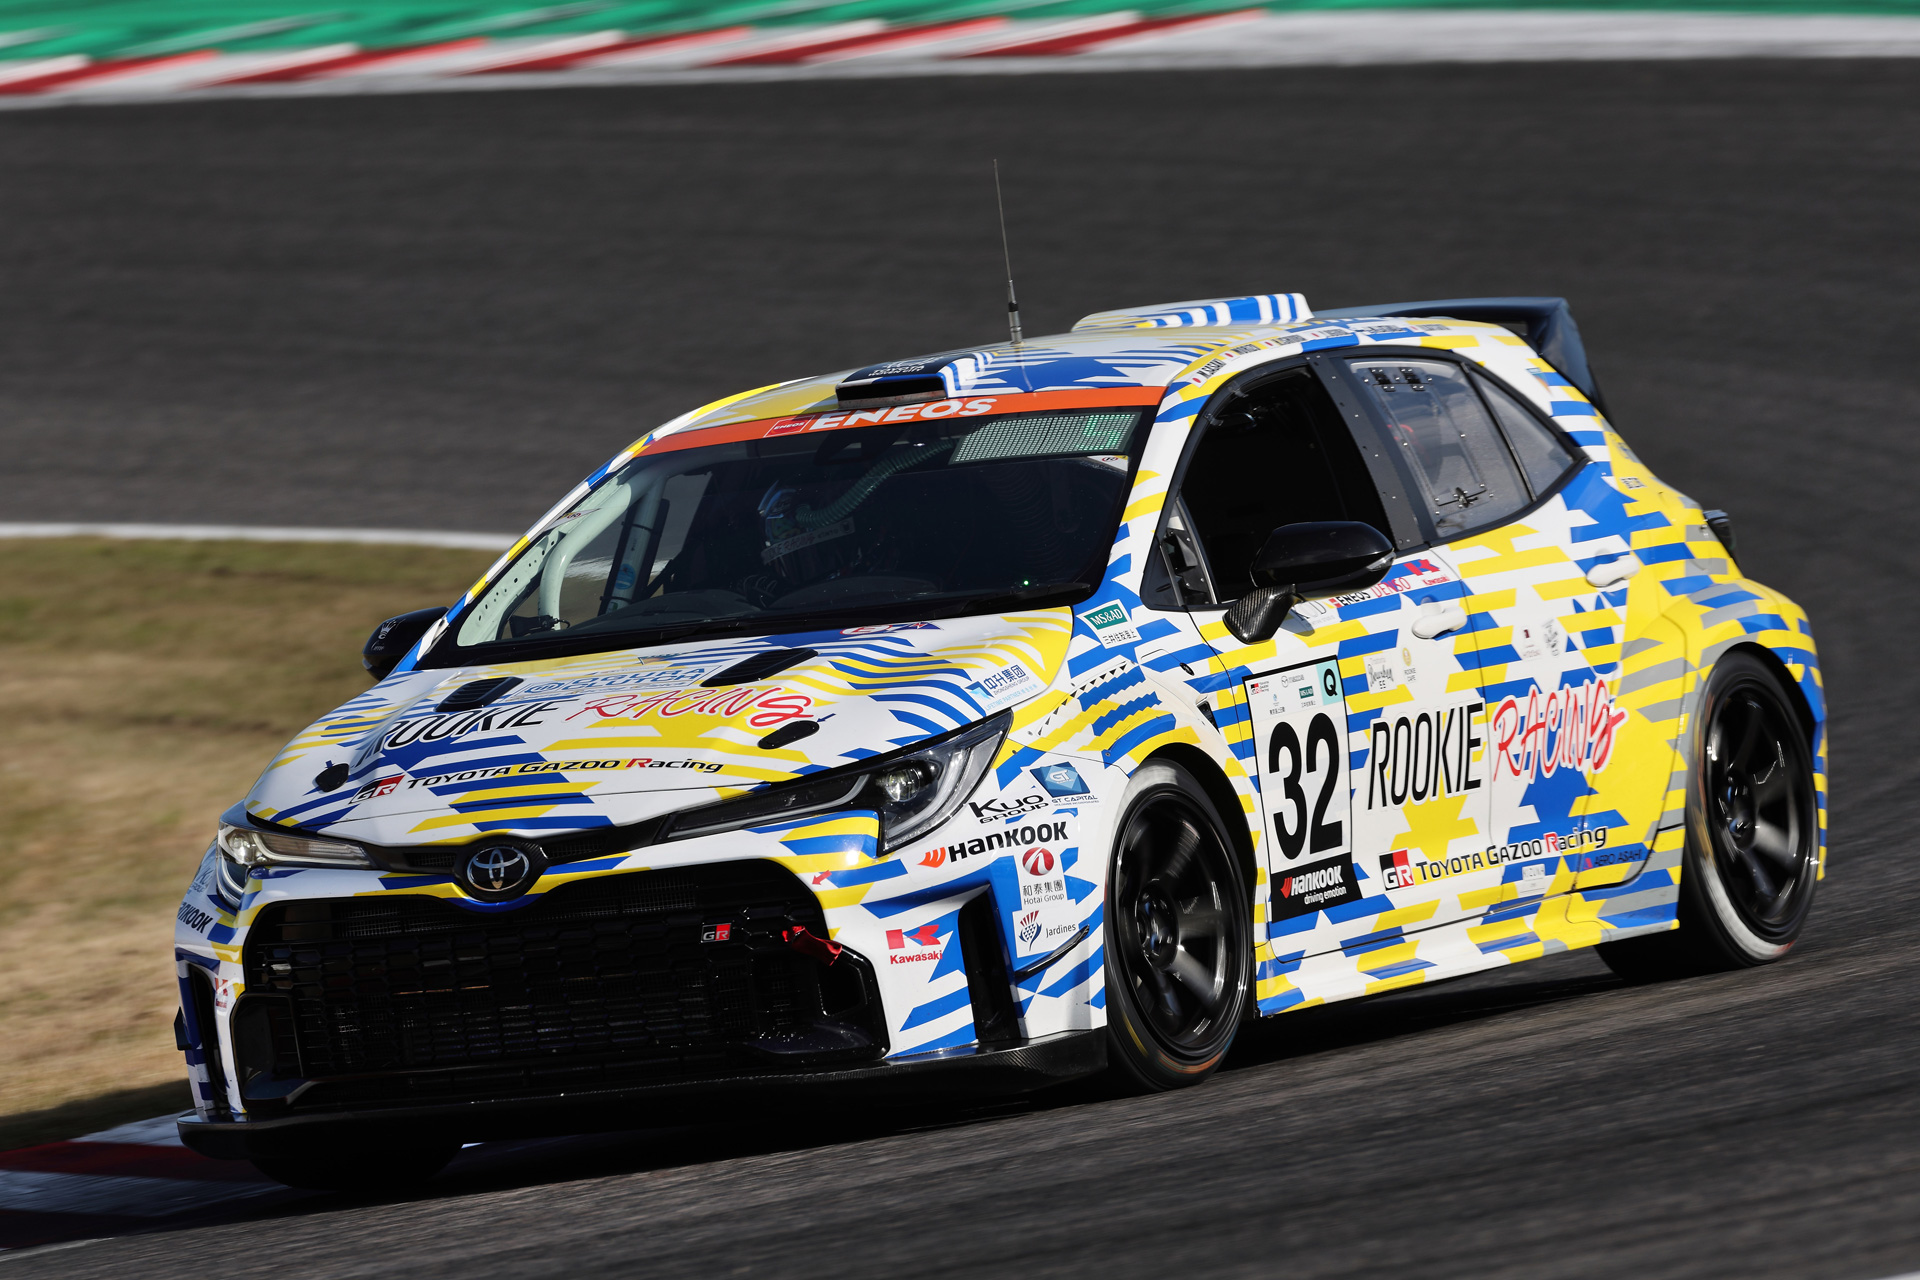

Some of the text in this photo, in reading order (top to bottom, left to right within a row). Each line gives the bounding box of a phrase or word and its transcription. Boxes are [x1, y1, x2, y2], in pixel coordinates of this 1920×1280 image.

[809, 398, 998, 431] ENEOS
[774, 421, 805, 431] ENEOS
[1370, 577, 1411, 598] DENSO
[1336, 591, 1371, 607] ENEOS
[1090, 608, 1123, 625] MS&AD
[561, 674, 700, 691] CLUTCH
[983, 664, 1027, 690] 中升集团
[1324, 668, 1338, 697] Q
[565, 687, 815, 728] RACING
[1367, 679, 1626, 810] ROOKIE RACING
[354, 757, 724, 802] GR TOYOTA GAZOO Racing
[1268, 712, 1343, 860] 32
[1064, 794, 1098, 803] CAPITAL
[979, 802, 1049, 824] GROUP
[1382, 826, 1608, 890] GR TOYOTA GAZOO Racing
[1593, 848, 1643, 867] AERO ASAHI
[1023, 893, 1065, 905] Hotai Group
[1304, 885, 1347, 905] driving emotion
[702, 927, 730, 941] GR
[1046, 923, 1077, 938] Jardines
[890, 949, 943, 965] Kawasaki
